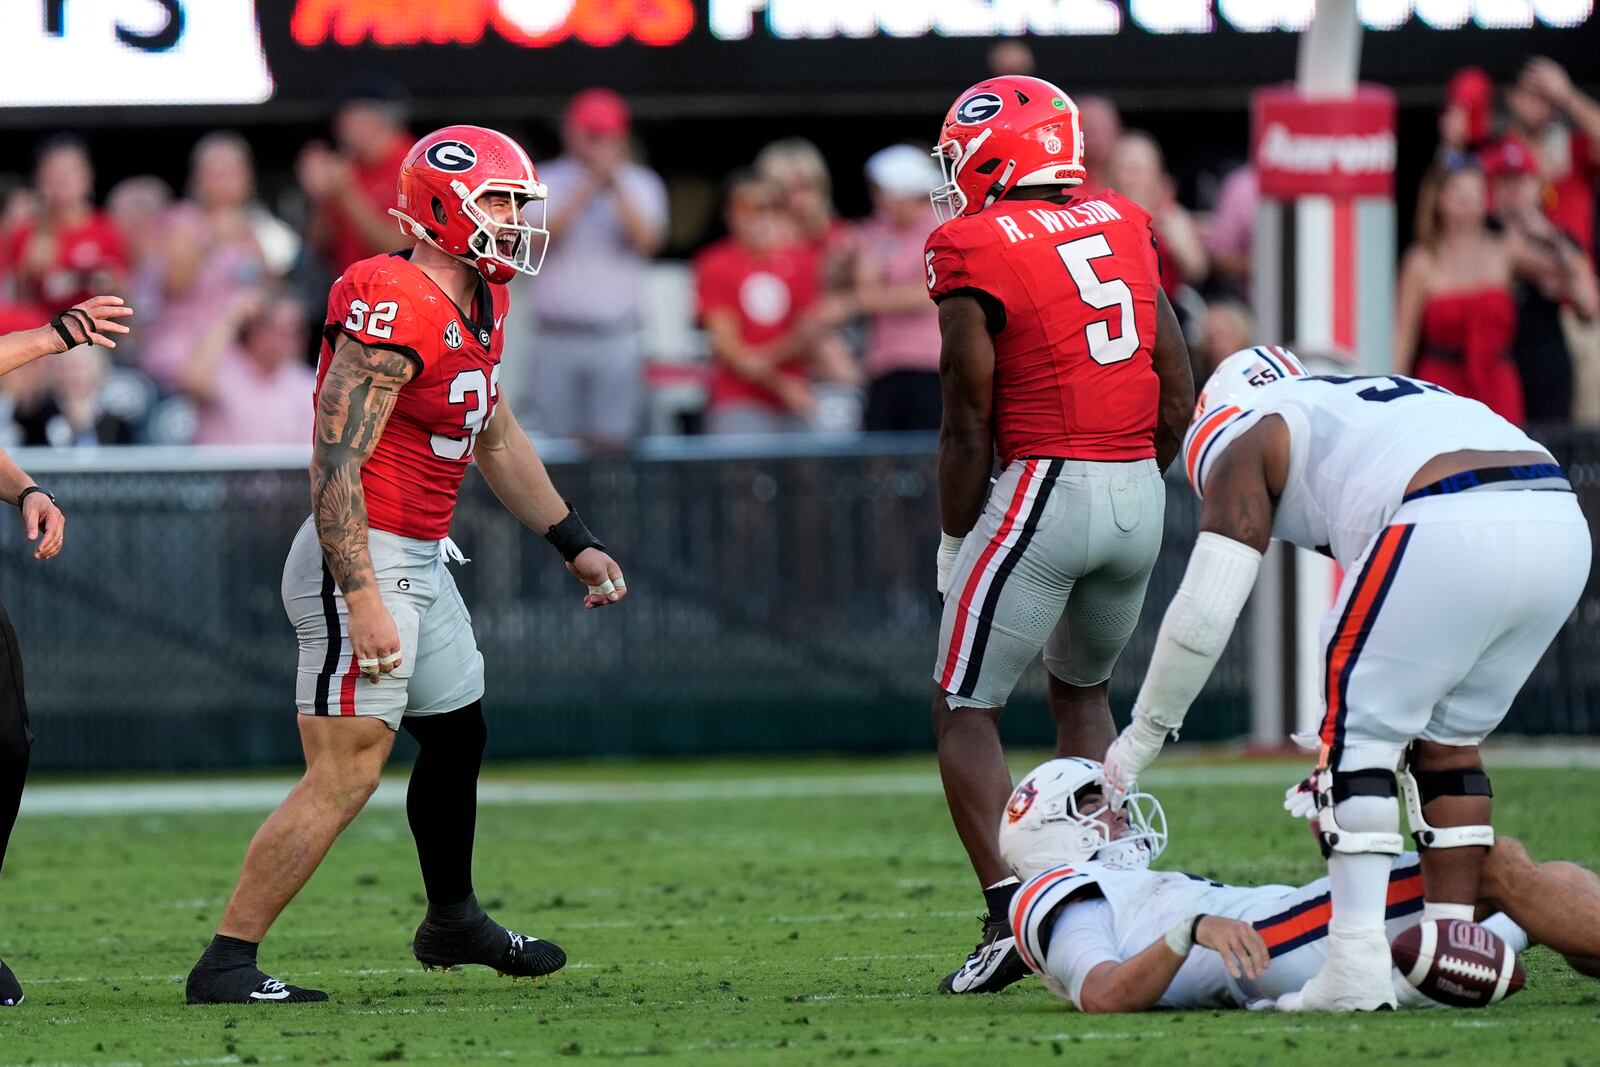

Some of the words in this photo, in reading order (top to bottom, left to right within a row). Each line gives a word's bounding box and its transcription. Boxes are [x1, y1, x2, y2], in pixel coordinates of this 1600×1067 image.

[955, 92, 1003, 125] G
[425, 140, 477, 173] G
[996, 215, 1034, 243] R.
[1027, 199, 1122, 234] WILSON
[924, 250, 936, 290] 5
[1055, 232, 1140, 366] 5
[345, 299, 399, 339] 32
[1248, 368, 1277, 387] 55
[396, 578, 410, 591] G
